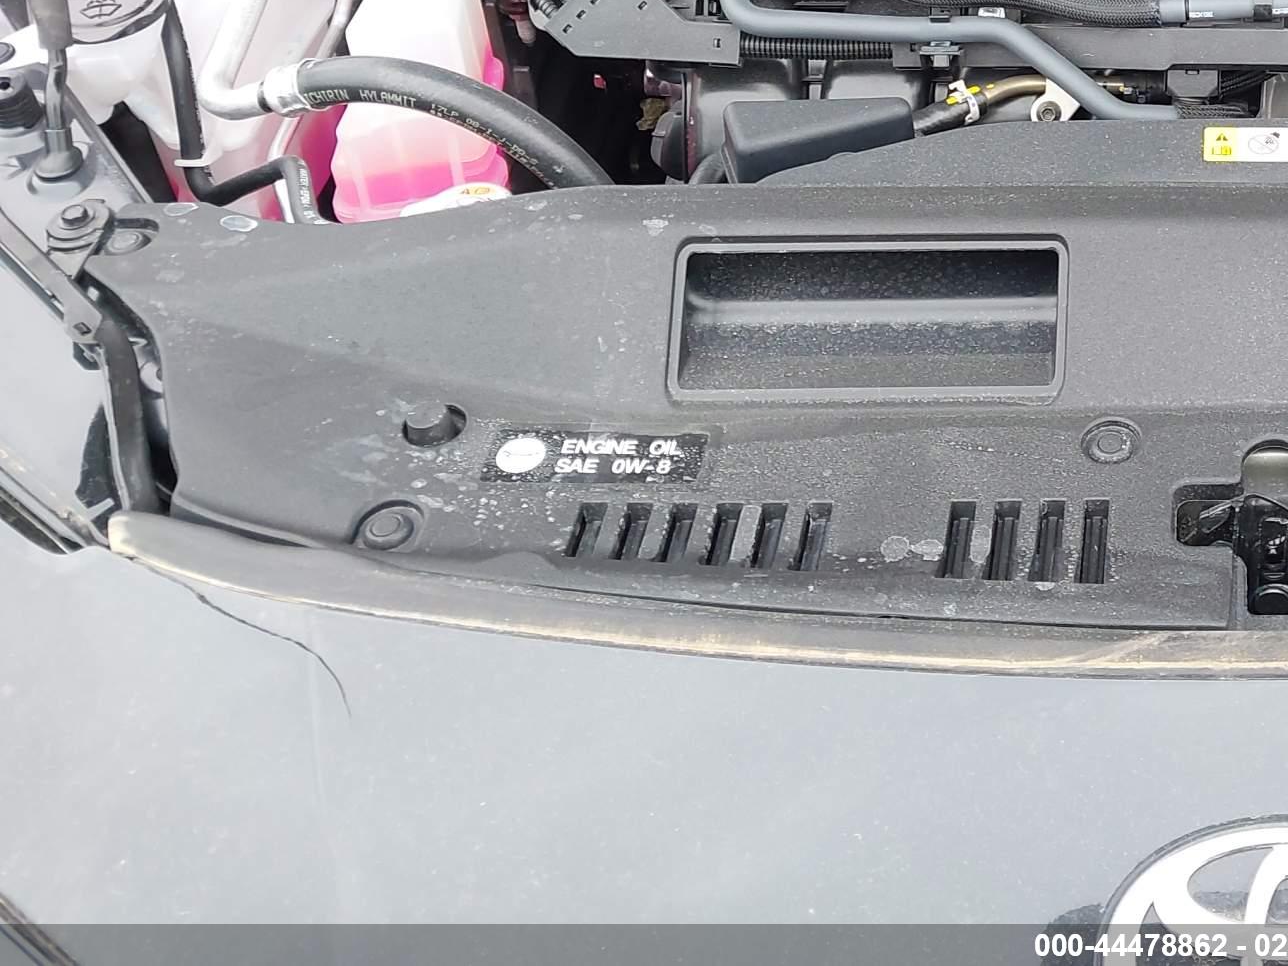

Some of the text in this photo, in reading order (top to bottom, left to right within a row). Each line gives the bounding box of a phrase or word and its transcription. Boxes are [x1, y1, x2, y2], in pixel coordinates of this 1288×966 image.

[560, 438, 683, 456] ENGINE OIL
[554, 458, 672, 475] SAE 0W-8
